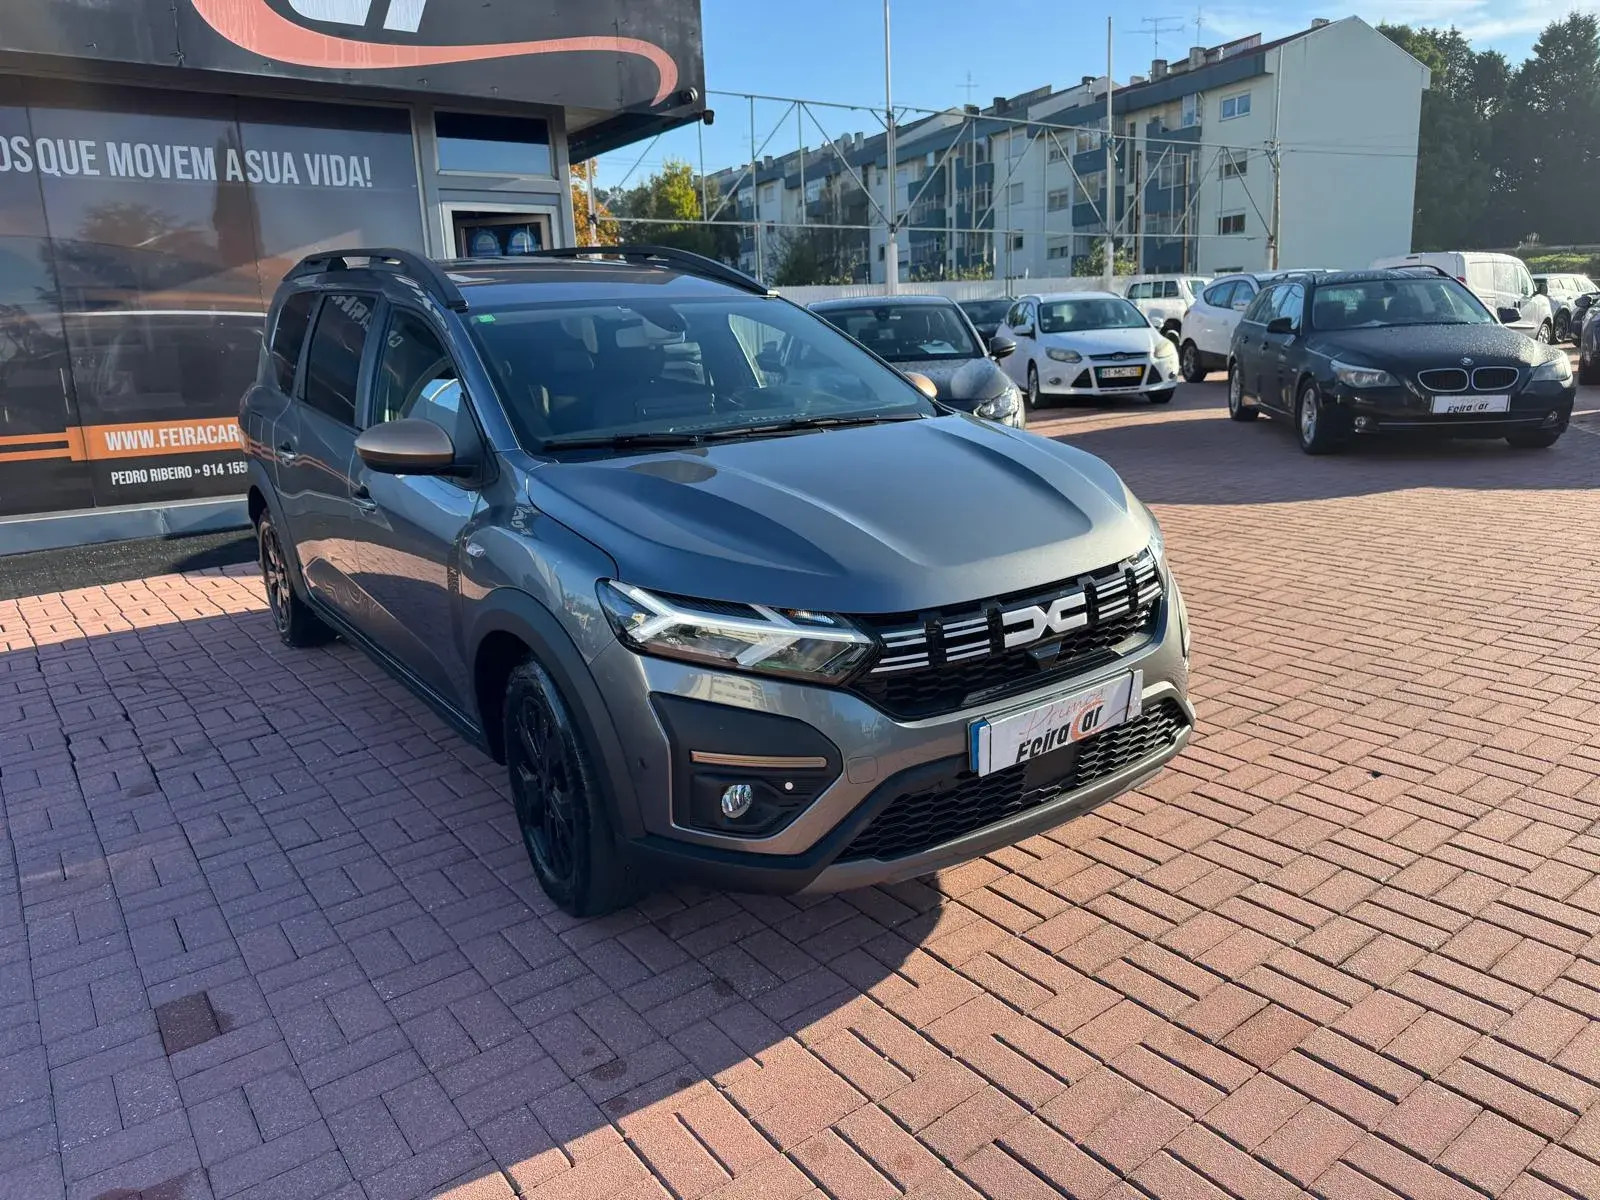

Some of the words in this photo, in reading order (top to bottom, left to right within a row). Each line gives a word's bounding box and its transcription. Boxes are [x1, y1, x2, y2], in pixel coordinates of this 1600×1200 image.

[35, 138, 101, 177] QUE
[106, 142, 217, 181] MOVEM
[225, 149, 245, 182] A
[244, 150, 300, 185] SUA
[304, 153, 373, 187] VIDA!
[111, 469, 148, 486] PEDRO
[150, 465, 193, 482] RIBEIRO
[202, 463, 225, 477] 914
